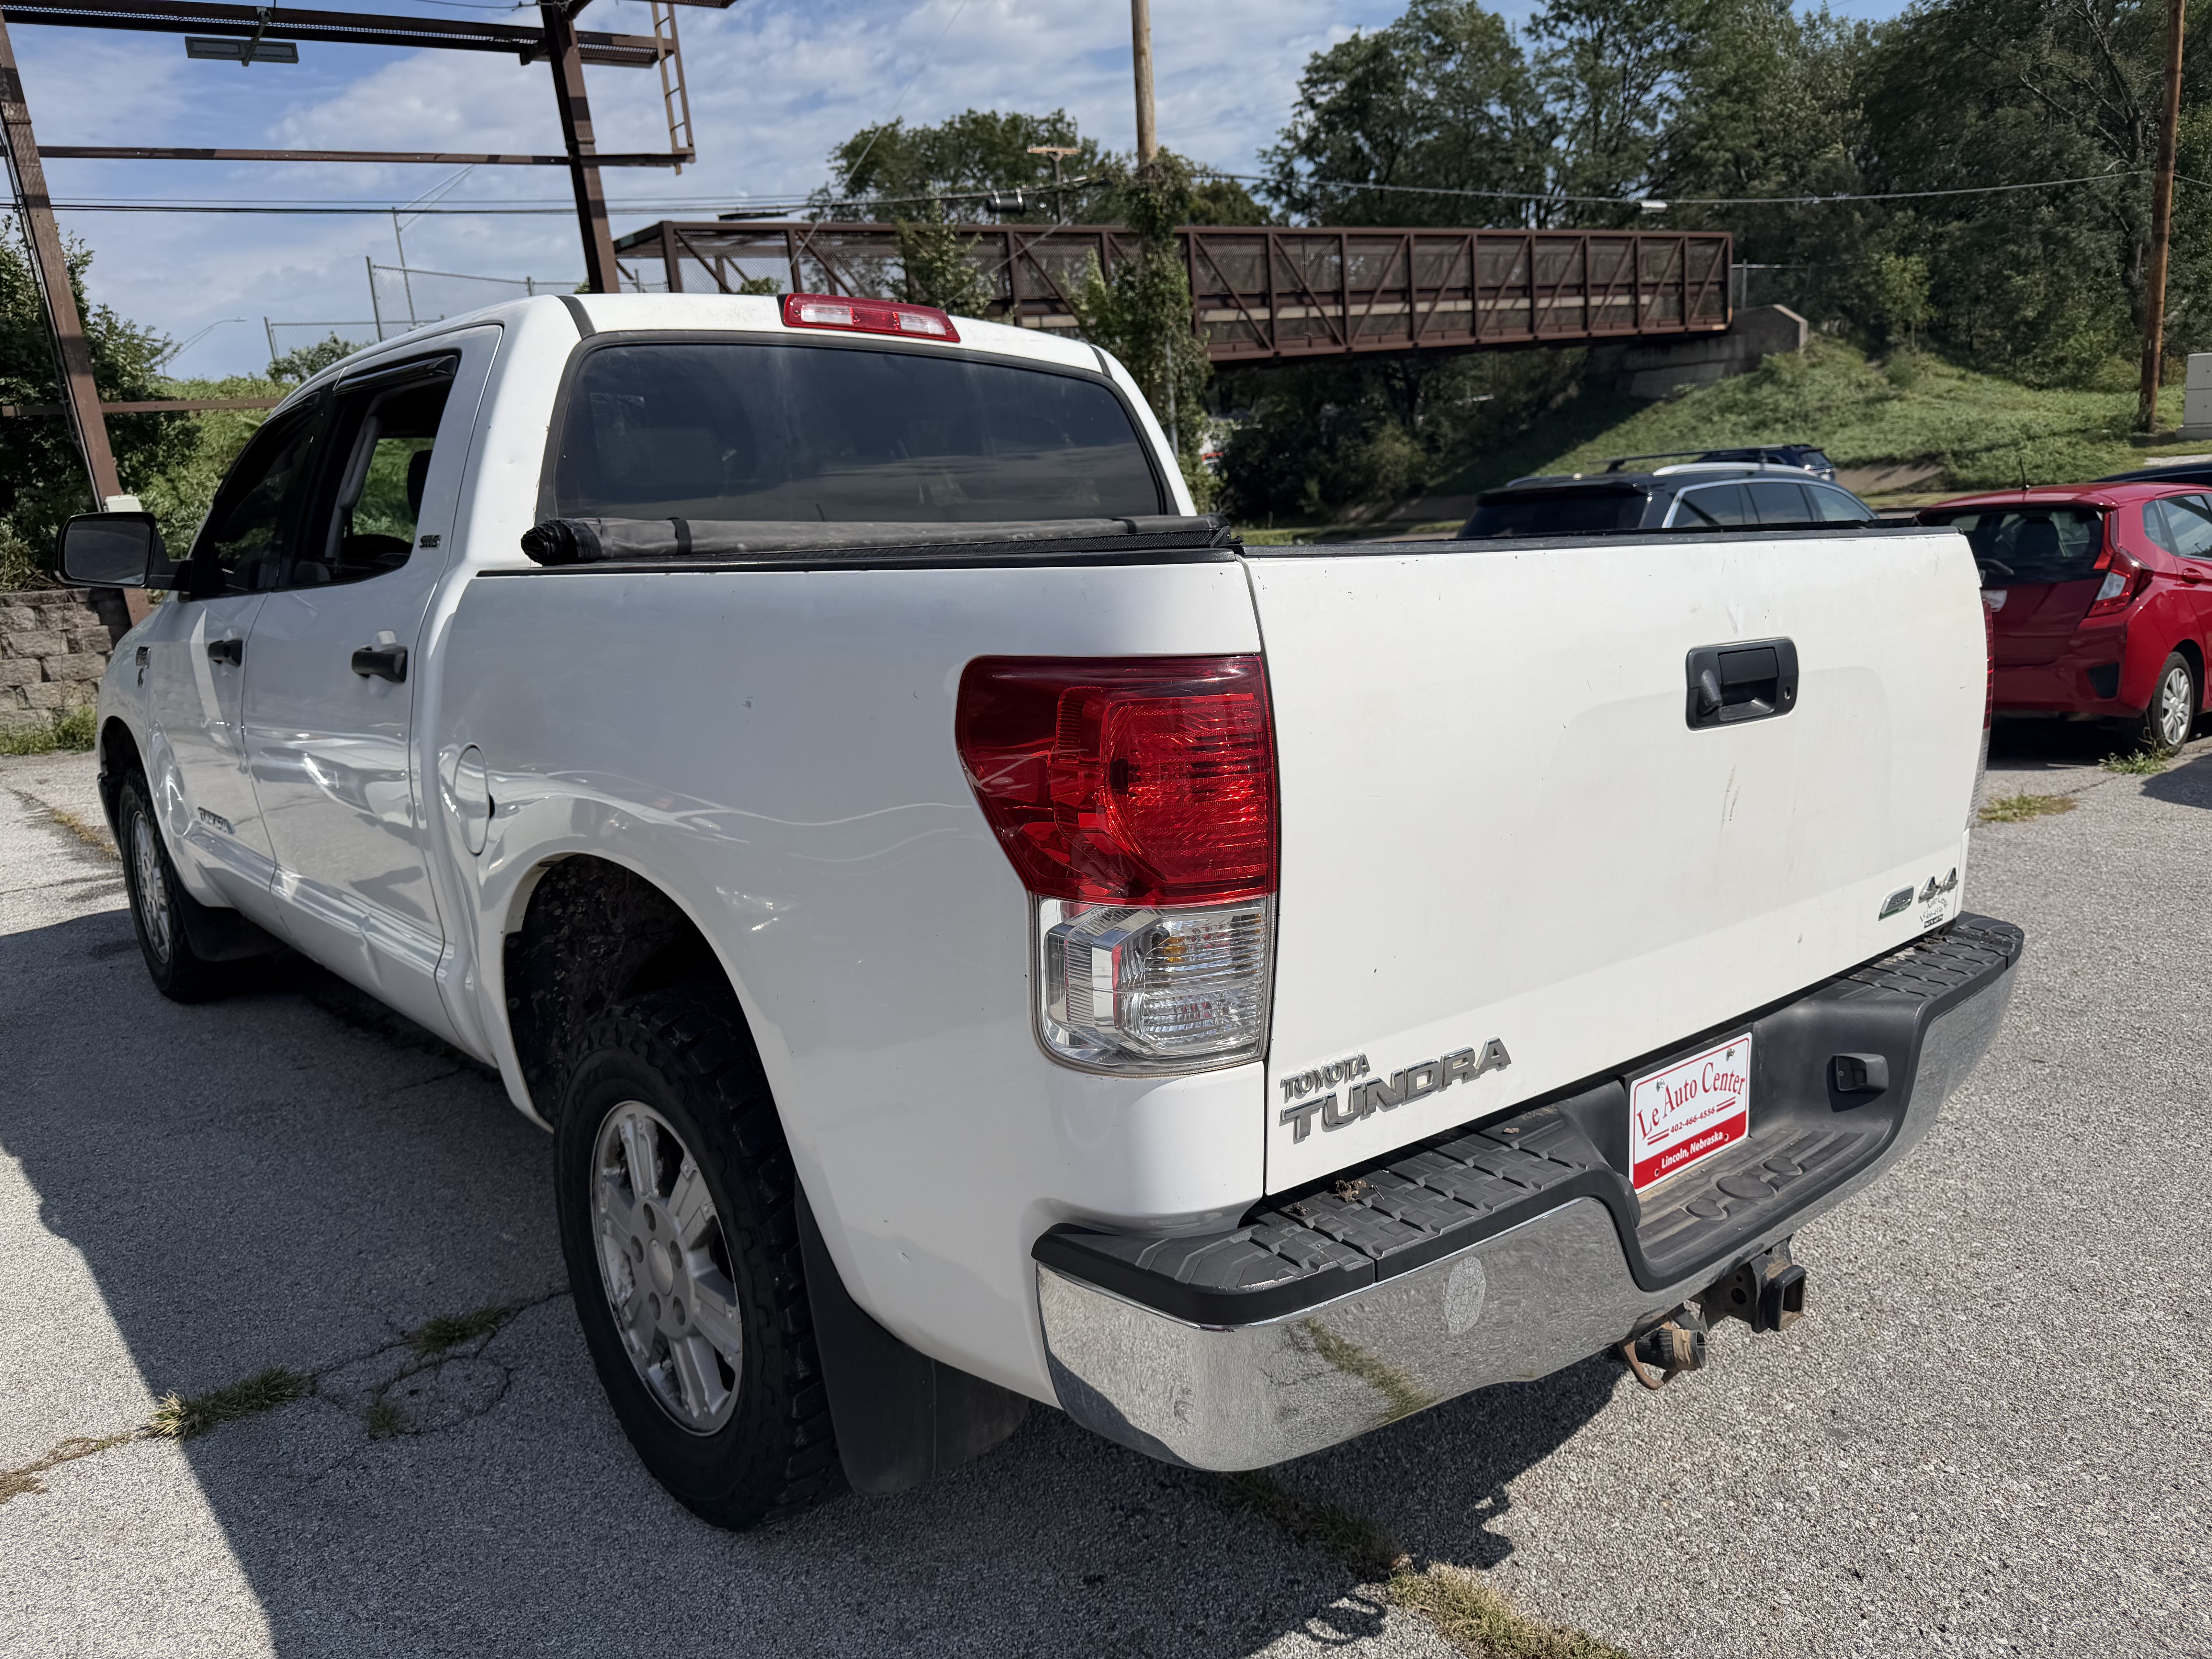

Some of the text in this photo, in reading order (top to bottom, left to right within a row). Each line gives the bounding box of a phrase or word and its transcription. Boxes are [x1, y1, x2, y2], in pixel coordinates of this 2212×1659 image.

[1282, 1053, 1370, 1099] TOYOTA
[1282, 1037, 1512, 1140] TUNDRA
[1637, 1062, 1746, 1140] Le Auto Center
[1670, 1107, 1716, 1133] 402-466-4556
[1661, 1130, 1723, 1169] Lincoln, Nebraska
